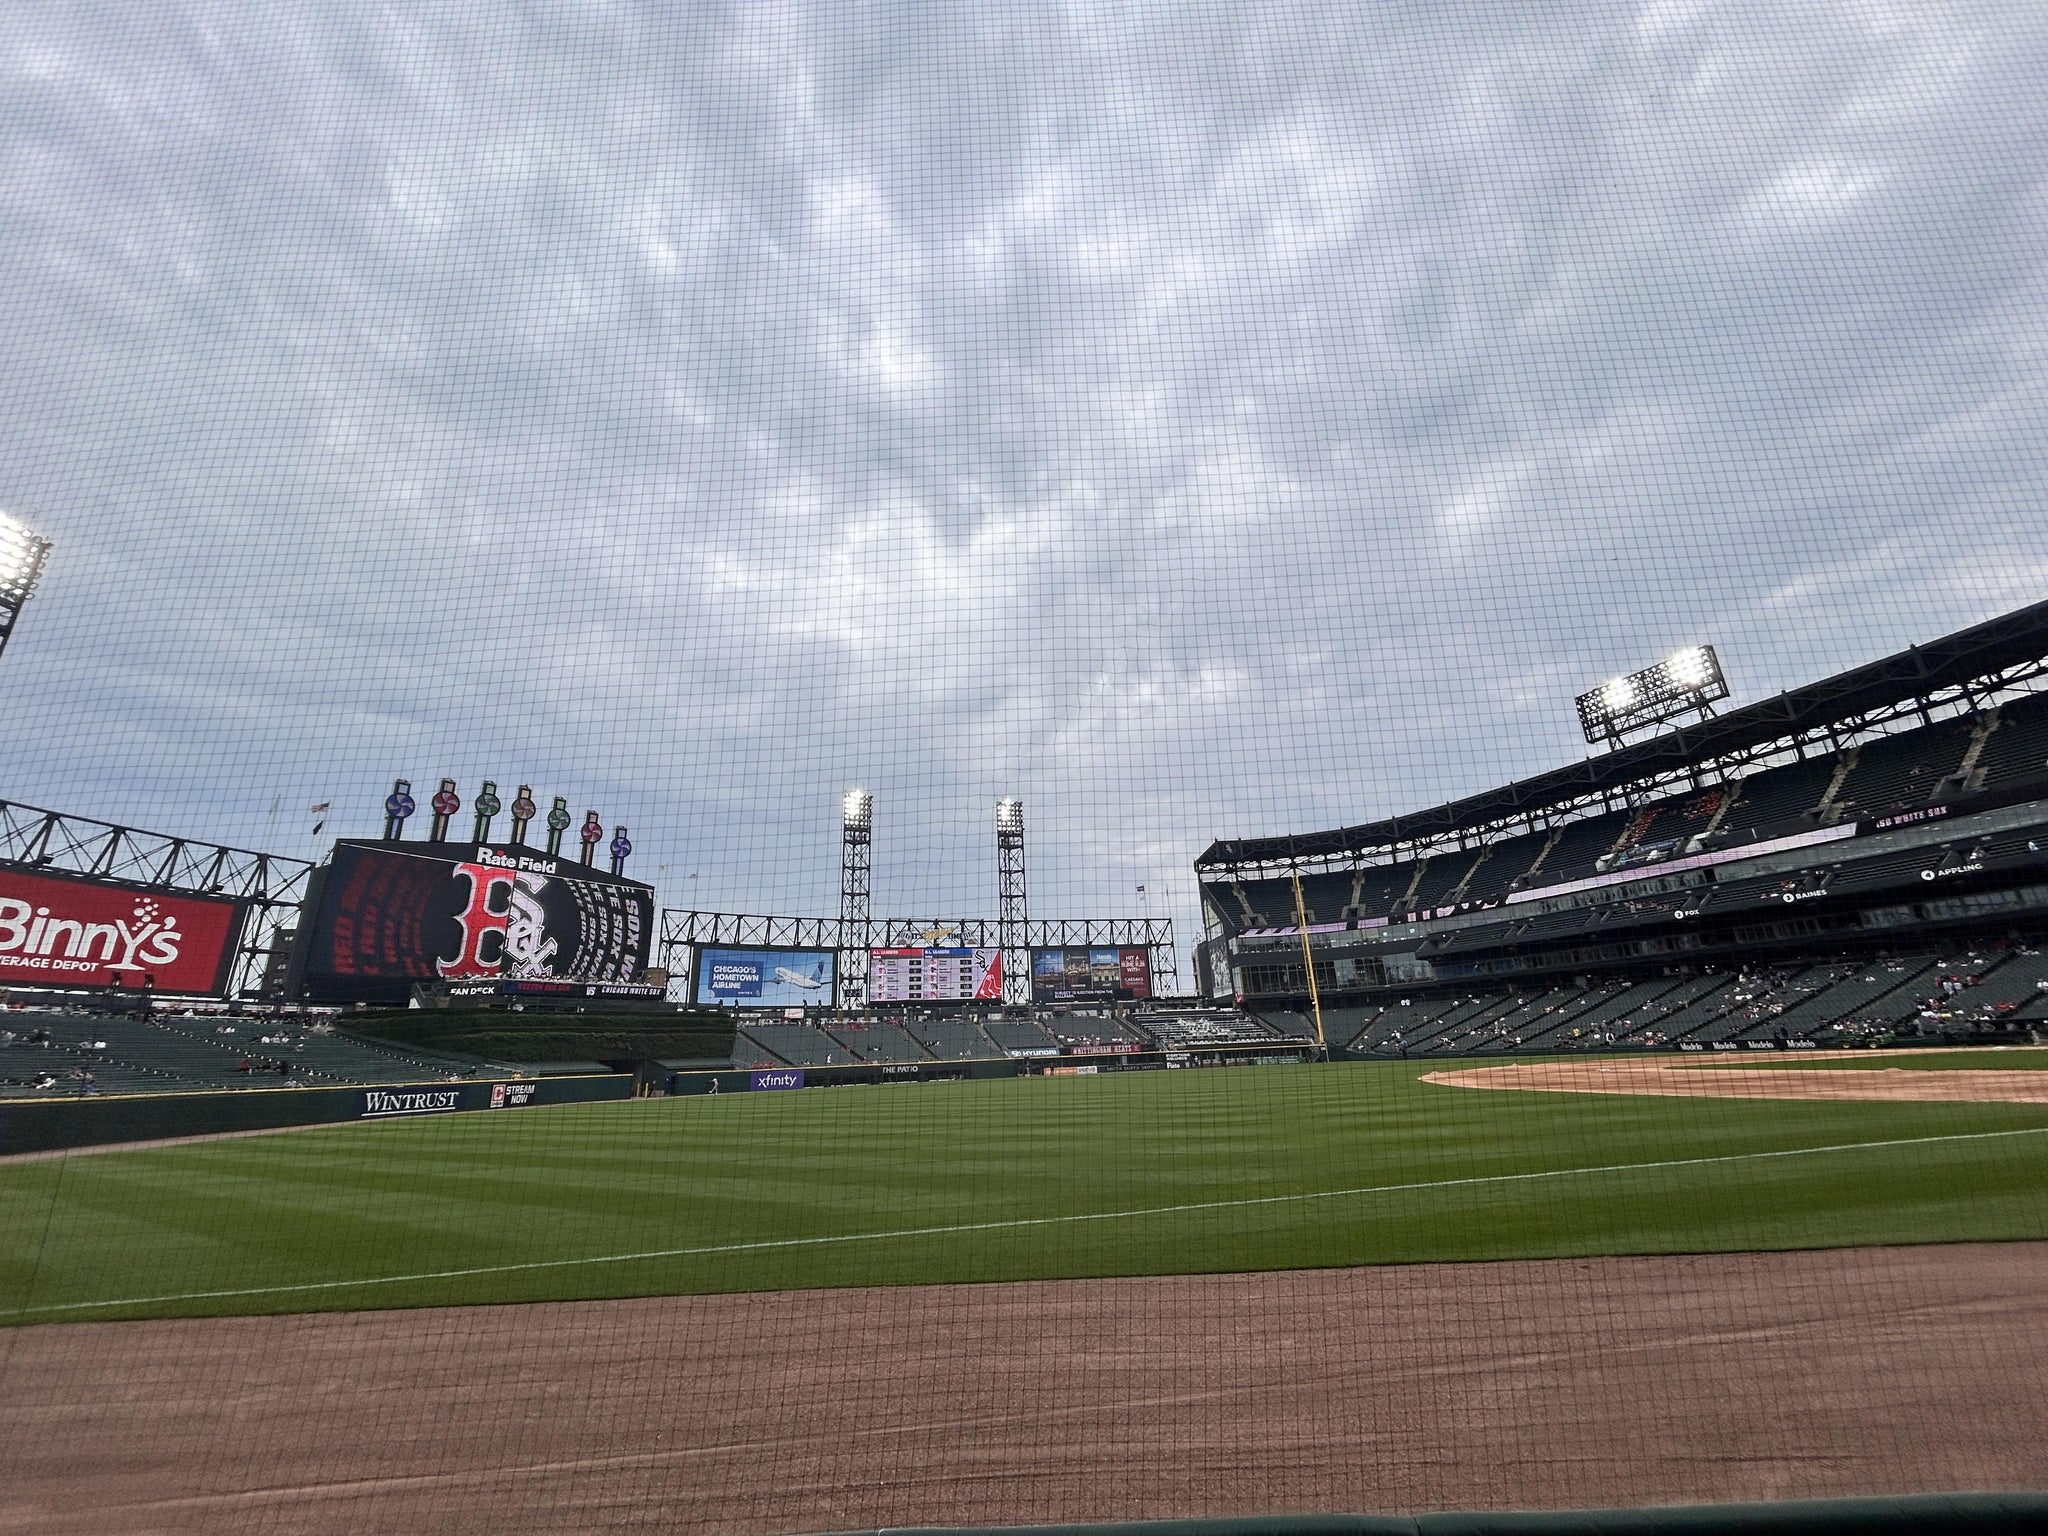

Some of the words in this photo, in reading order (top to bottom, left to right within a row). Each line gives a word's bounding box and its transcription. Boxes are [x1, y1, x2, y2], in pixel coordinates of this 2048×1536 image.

[476, 847, 517, 868] Rate
[518, 856, 557, 874] Field
[1938, 863, 1983, 876] APPLING
[1795, 889, 1827, 900] BAINES
[1685, 909, 1700, 917] FOX
[624, 899, 640, 950] SOX
[613, 913, 623, 959] SOX
[52, 959, 99, 972] DEPOT
[713, 965, 756, 974] CHICAGO'S
[713, 973, 759, 982] HOMETOWN
[712, 981, 741, 989] AIRLINE
[601, 986, 628, 994] CHICAGO
[629, 987, 648, 995] WHITE
[649, 988, 661, 996] SOX
[1712, 1042, 1737, 1050] Modelo
[1748, 1041, 1774, 1049] Modelo
[1786, 1039, 1816, 1048] Modelo
[1022, 1049, 1057, 1057] HYUNDAI
[897, 1065, 919, 1073] PATIO
[758, 1073, 797, 1089] xfinity
[506, 1084, 536, 1096] STREAM
[365, 1091, 460, 1112] WINTRUST
[510, 1094, 529, 1104] NOW
